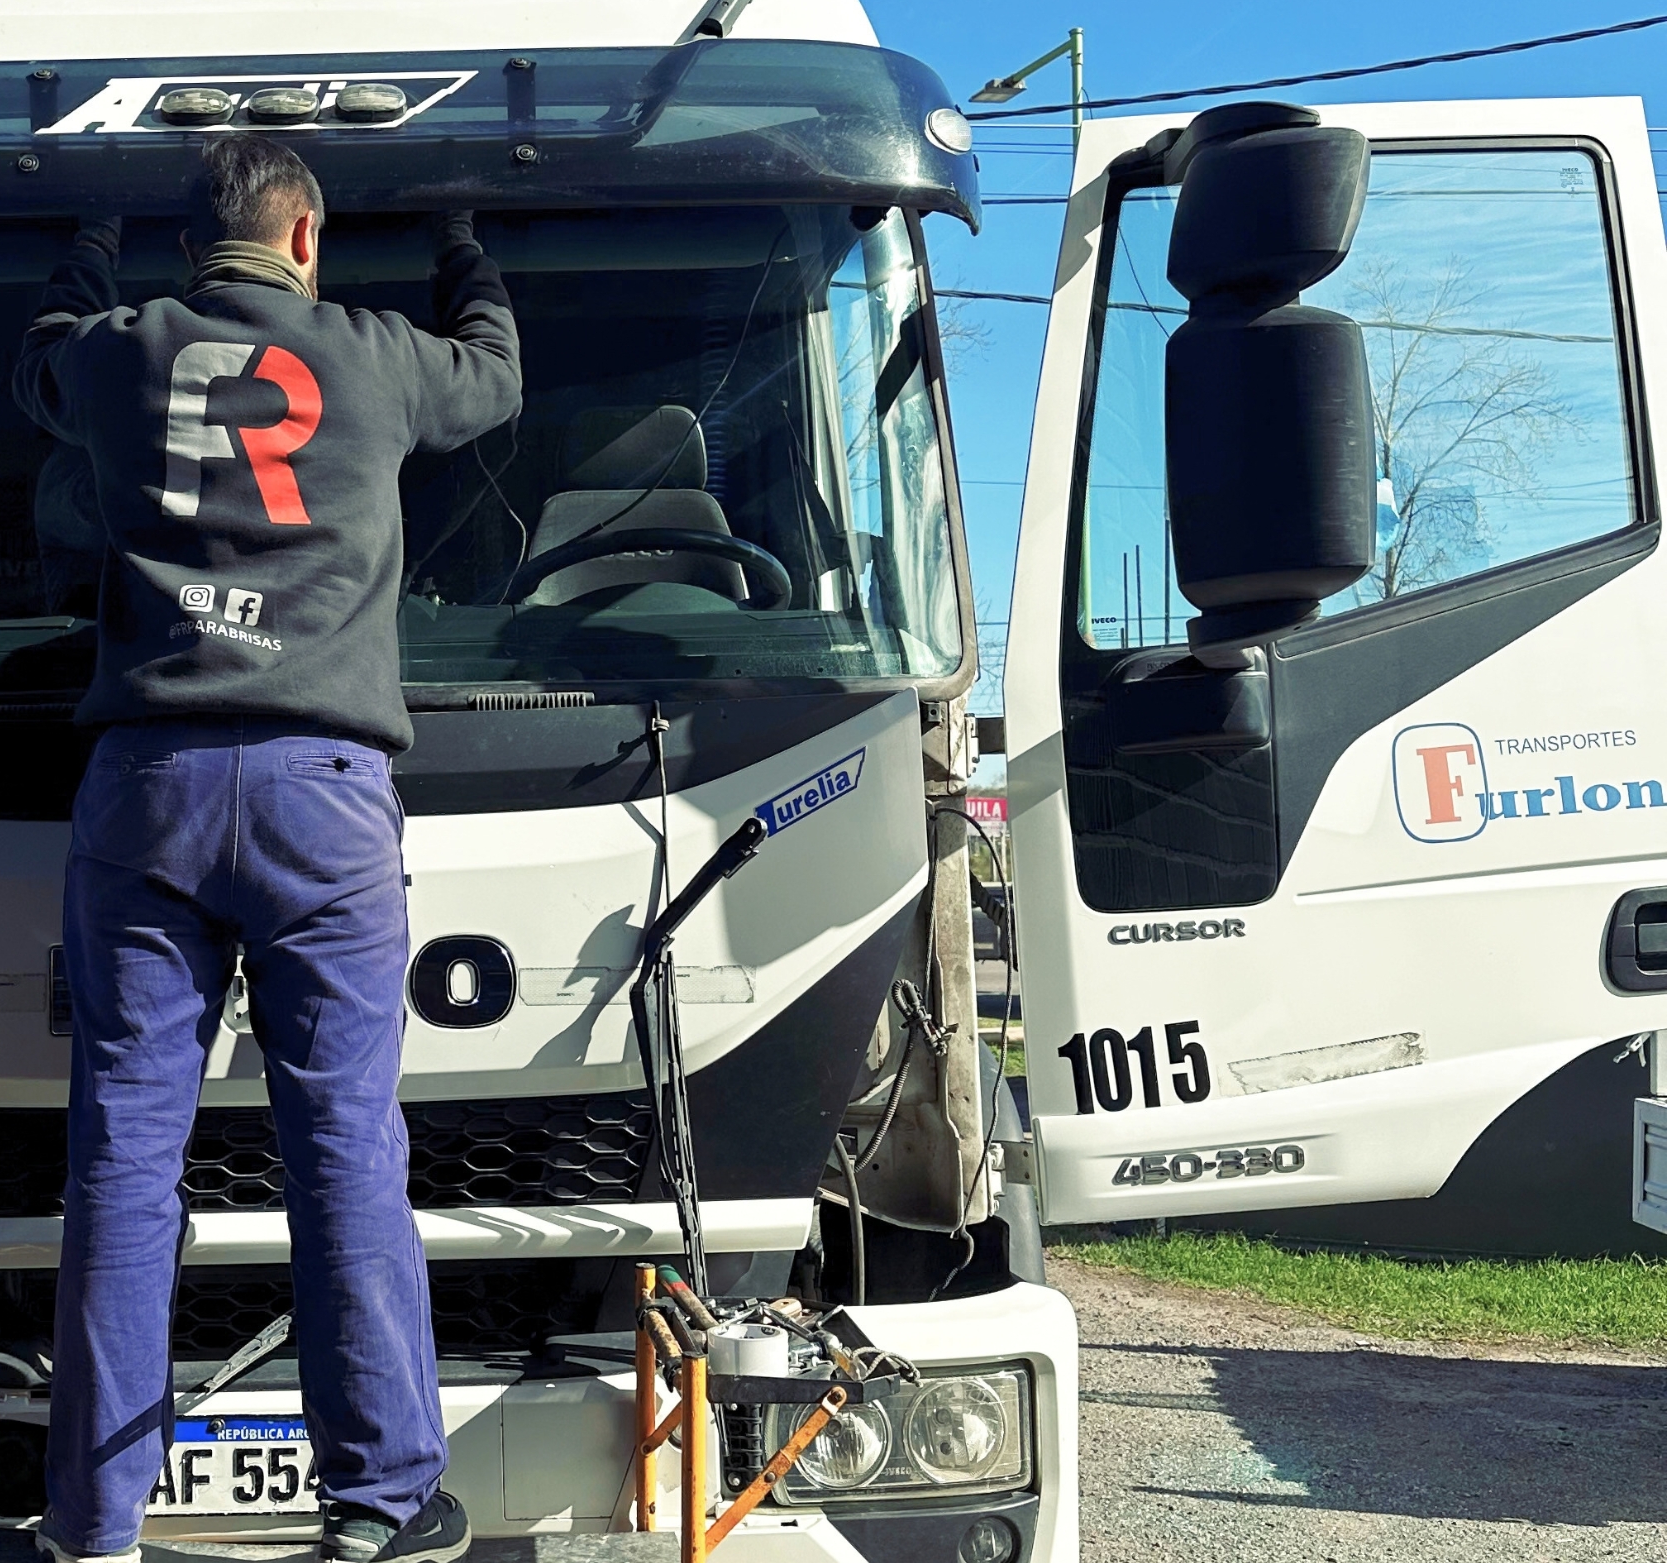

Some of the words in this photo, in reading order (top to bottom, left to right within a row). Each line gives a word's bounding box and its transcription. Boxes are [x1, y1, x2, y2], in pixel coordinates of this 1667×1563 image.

[161, 341, 323, 525] FR
[169, 619, 282, 651] @FRPARABRISAS
[1495, 730, 1637, 755] TRANSPORTES
[1107, 918, 1246, 945] CURSOR
[1057, 1020, 1211, 1115] 1015
[1111, 1144, 1305, 1186] 450-330
[217, 1426, 284, 1440] REPÚBLICA
